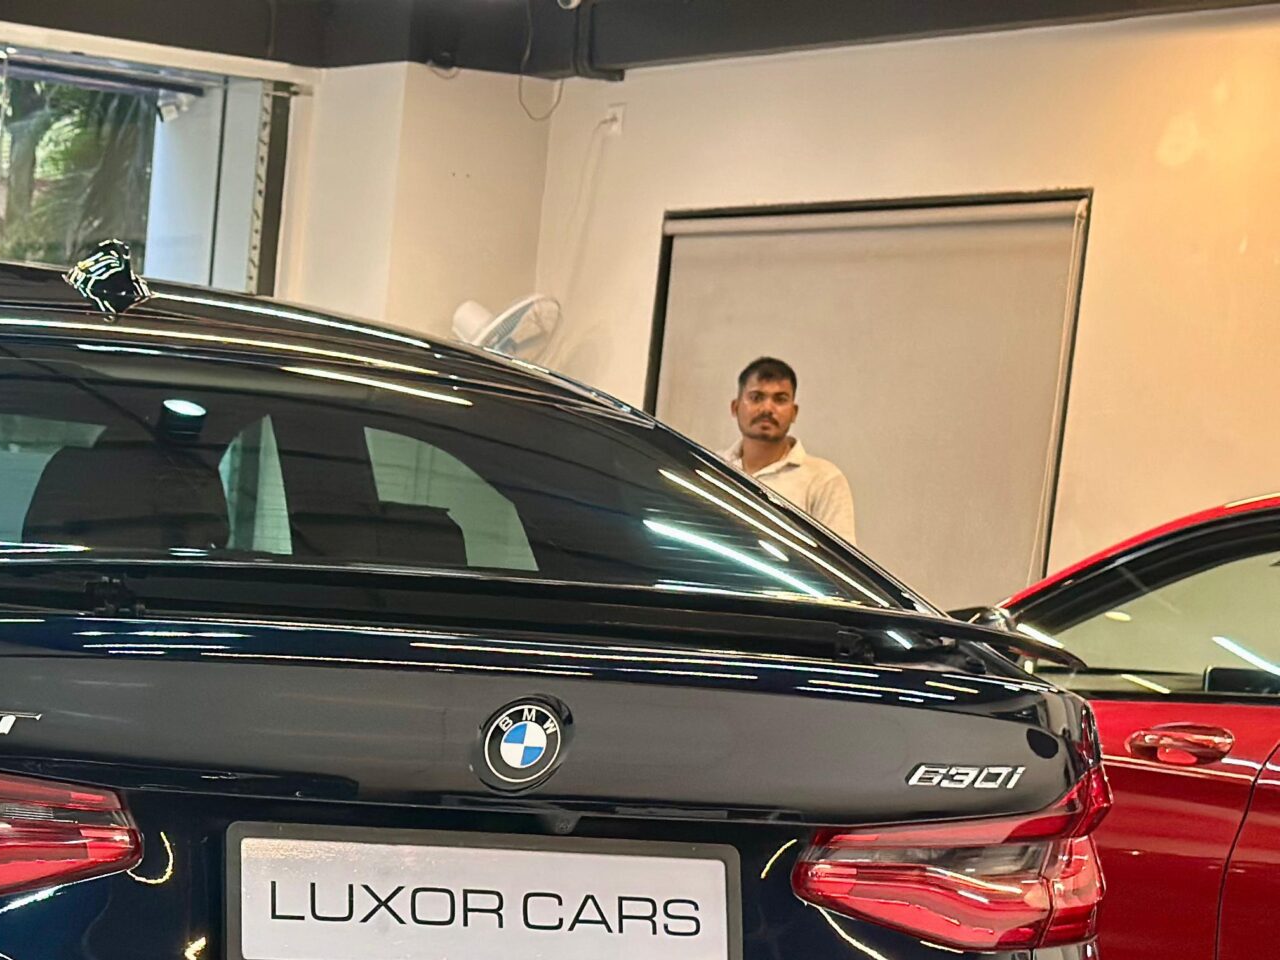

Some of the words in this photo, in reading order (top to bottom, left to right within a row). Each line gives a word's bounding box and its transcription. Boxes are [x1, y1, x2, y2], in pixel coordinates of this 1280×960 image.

[498, 707, 557, 735] BMW
[907, 764, 1026, 789] 630i
[270, 880, 504, 929] LUXOR
[522, 892, 701, 937] CARS
